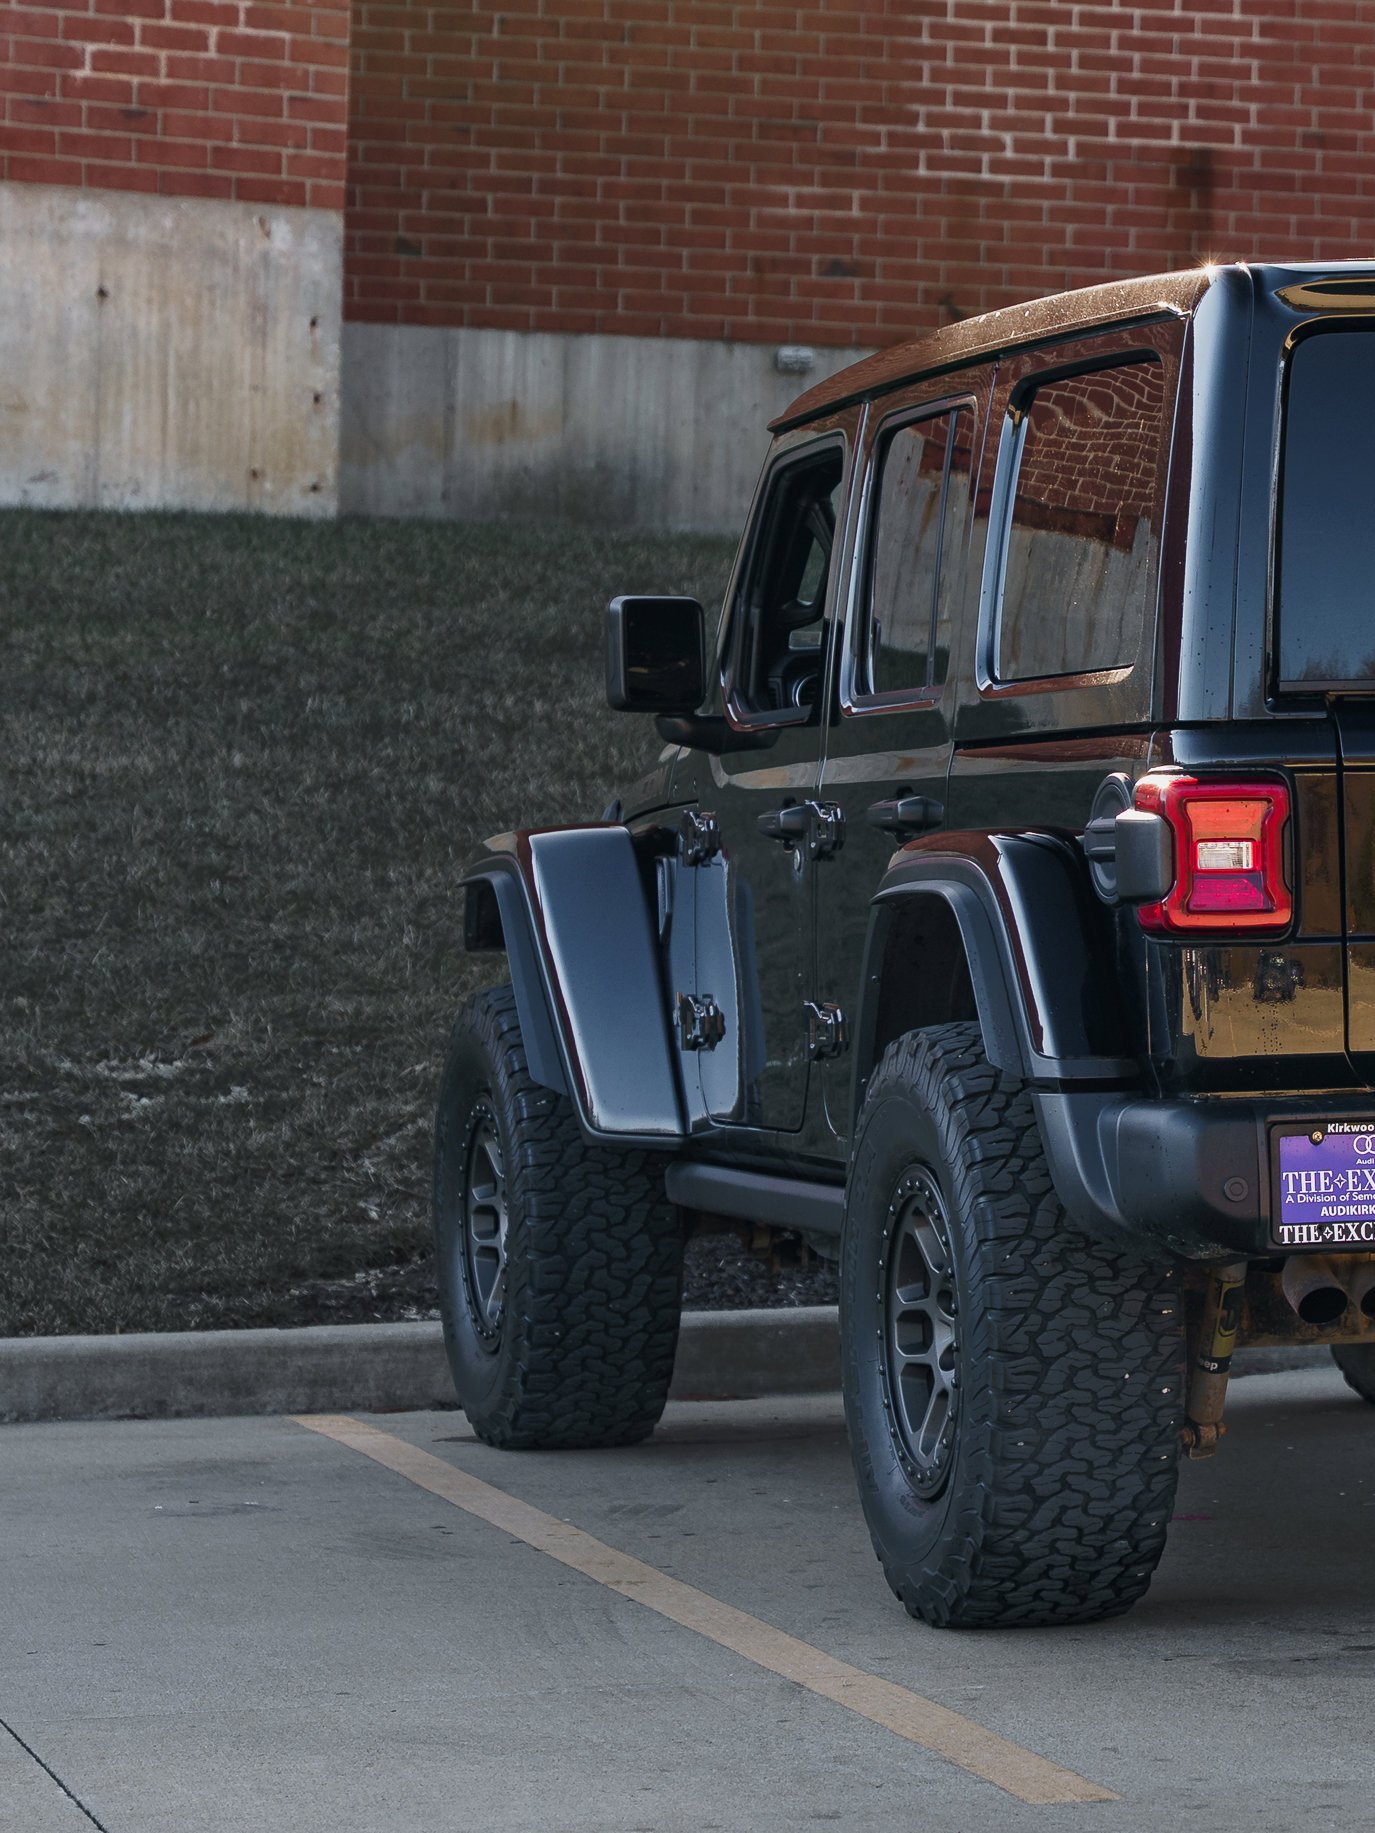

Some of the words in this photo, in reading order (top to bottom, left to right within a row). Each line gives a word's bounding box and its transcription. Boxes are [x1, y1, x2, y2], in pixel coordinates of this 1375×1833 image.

[1282, 1170, 1334, 1194] THE
[1285, 1194, 1295, 1204] A
[1297, 1192, 1336, 1203] Division
[1339, 1191, 1350, 1201] of
[1279, 1224, 1323, 1244] THE
